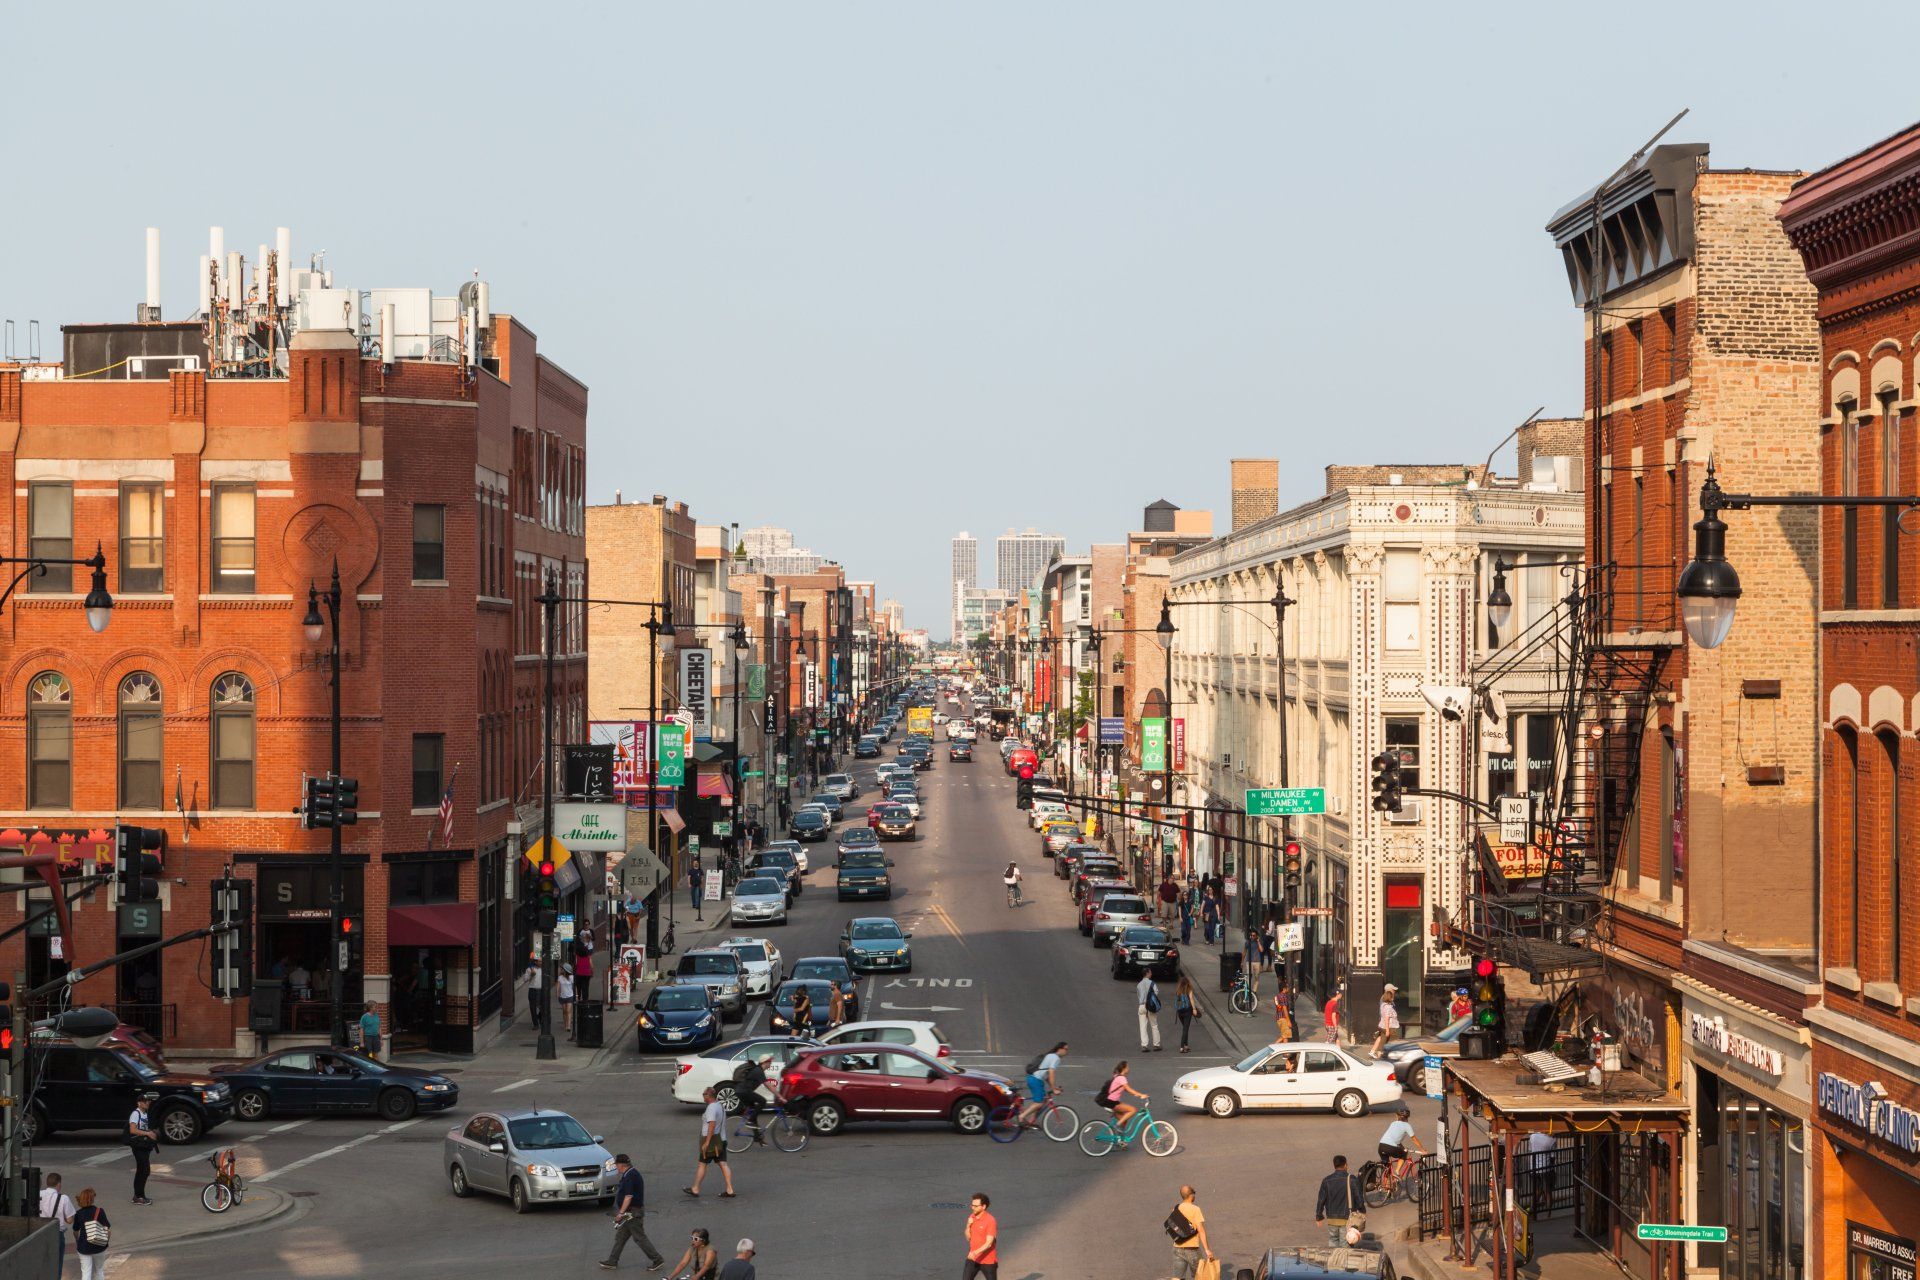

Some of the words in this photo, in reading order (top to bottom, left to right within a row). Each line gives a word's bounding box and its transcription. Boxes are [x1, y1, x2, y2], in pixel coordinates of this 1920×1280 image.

[688, 653, 704, 713] CHEETAH
[636, 731, 644, 777] WELCOME!
[1502, 758, 1517, 770] Cut
[1261, 790, 1306, 798] MILWAUKEE
[1270, 799, 1298, 807] DAMEN
[1510, 804, 1522, 813] NO
[581, 815, 599, 827] CAFE
[1507, 818, 1525, 826] LEFT
[562, 829, 618, 840] Absinthe
[1506, 830, 1526, 838] TURN
[278, 882, 292, 902] S
[133, 908, 148, 928] S
[884, 978, 973, 988] ONLY
[1819, 1072, 1864, 1128] DENTAL
[1876, 1100, 1920, 1153] CLINIC
[1664, 1230, 1701, 1238] Bloomingdale
[1853, 1230, 1862, 1243] DR.
[1863, 1234, 1892, 1253] MARRERO
[1892, 1243, 1897, 1255] &
[1891, 1266, 1914, 1280] FREE
